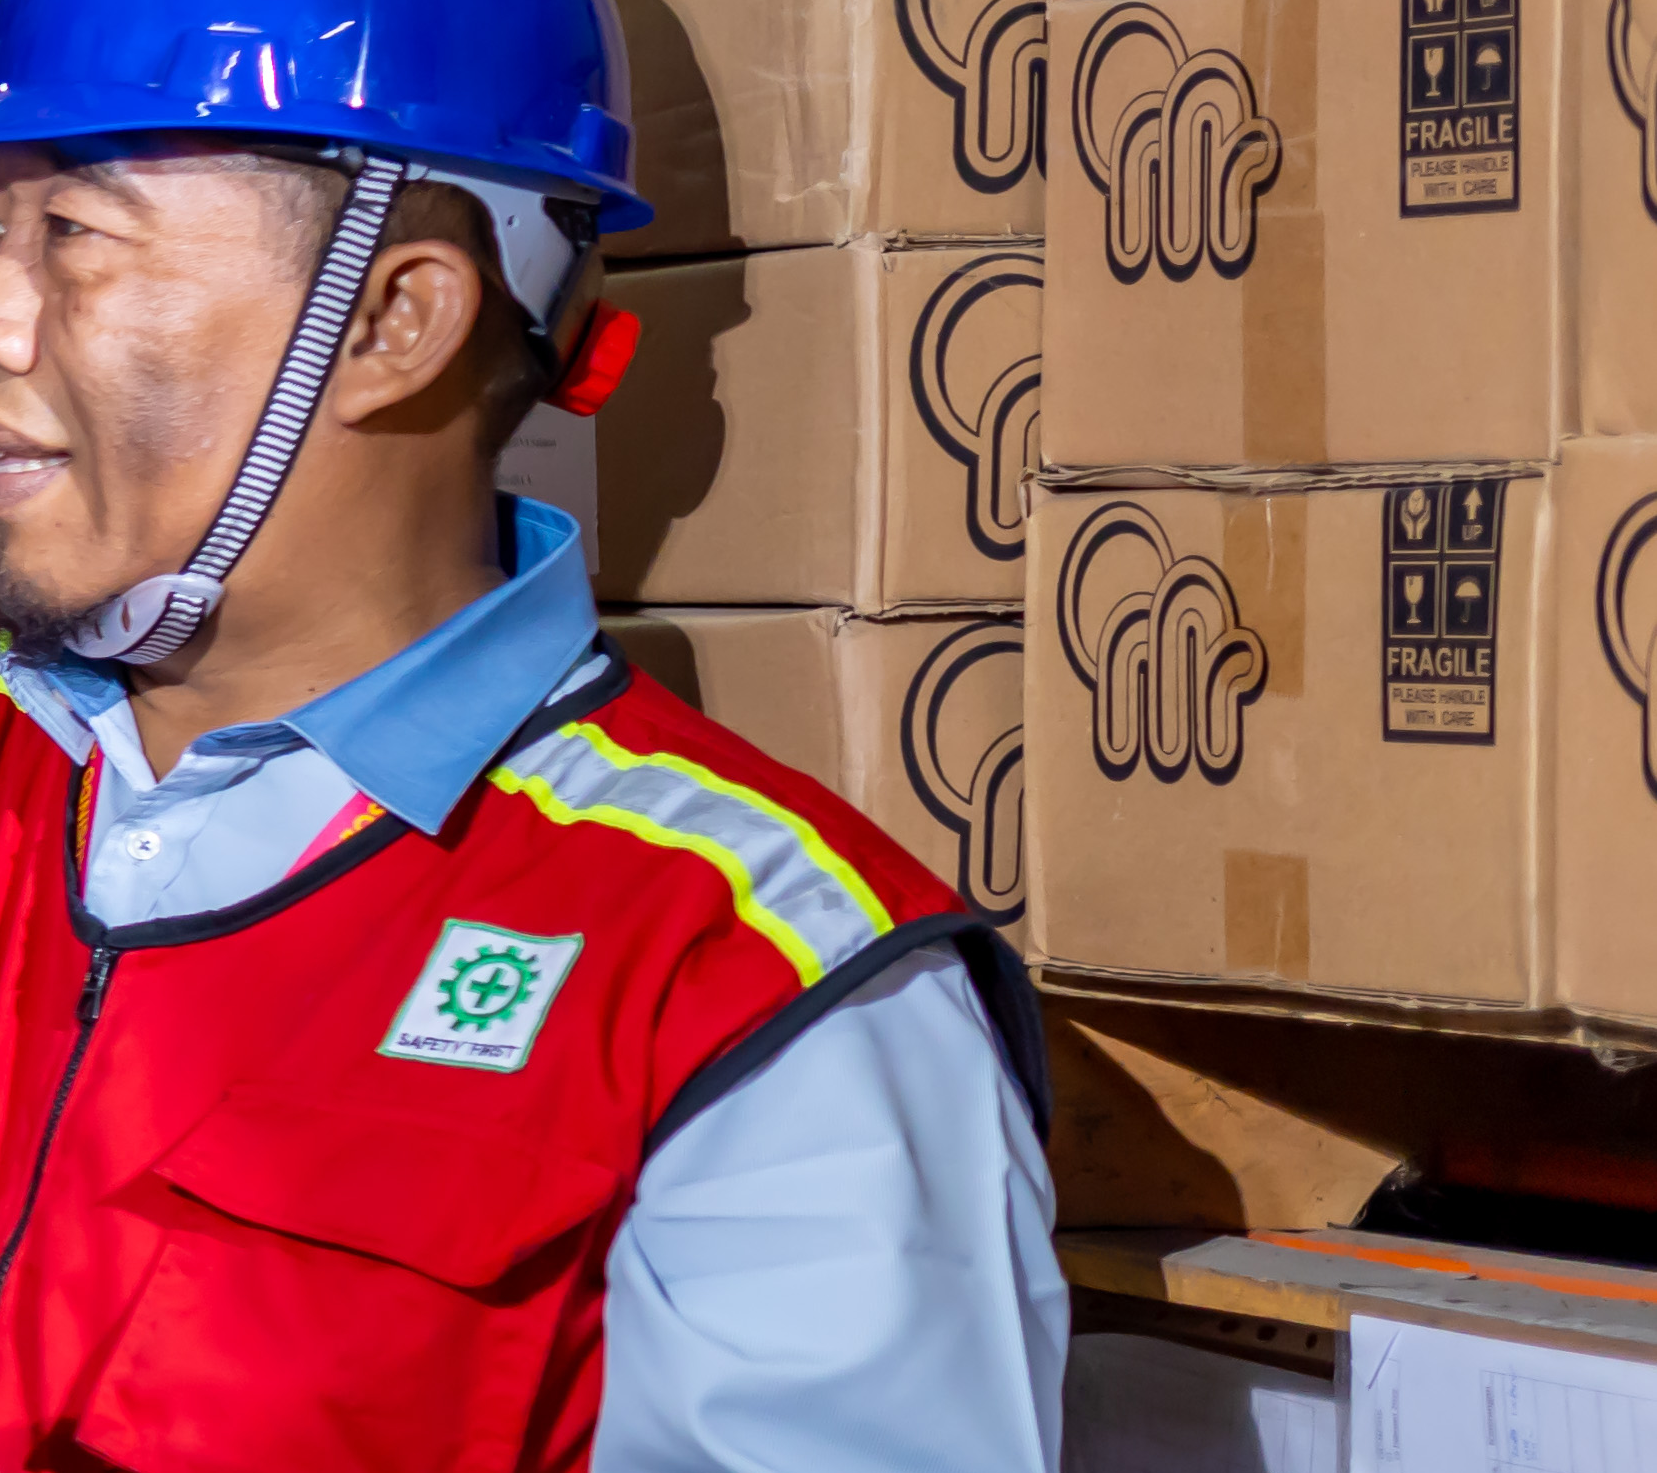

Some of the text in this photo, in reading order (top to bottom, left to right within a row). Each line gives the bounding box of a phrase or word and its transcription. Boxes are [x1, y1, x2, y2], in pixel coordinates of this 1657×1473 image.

[1405, 113, 1514, 152] FRAGILE
[1410, 160, 1458, 177] PLEASE
[1463, 178, 1497, 196] CARE
[1387, 647, 1492, 677] FRAGILE
[1392, 688, 1437, 703] PLEASE
[1440, 711, 1475, 726] CARE
[395, 1031, 521, 1059] SAFETY FIRST
